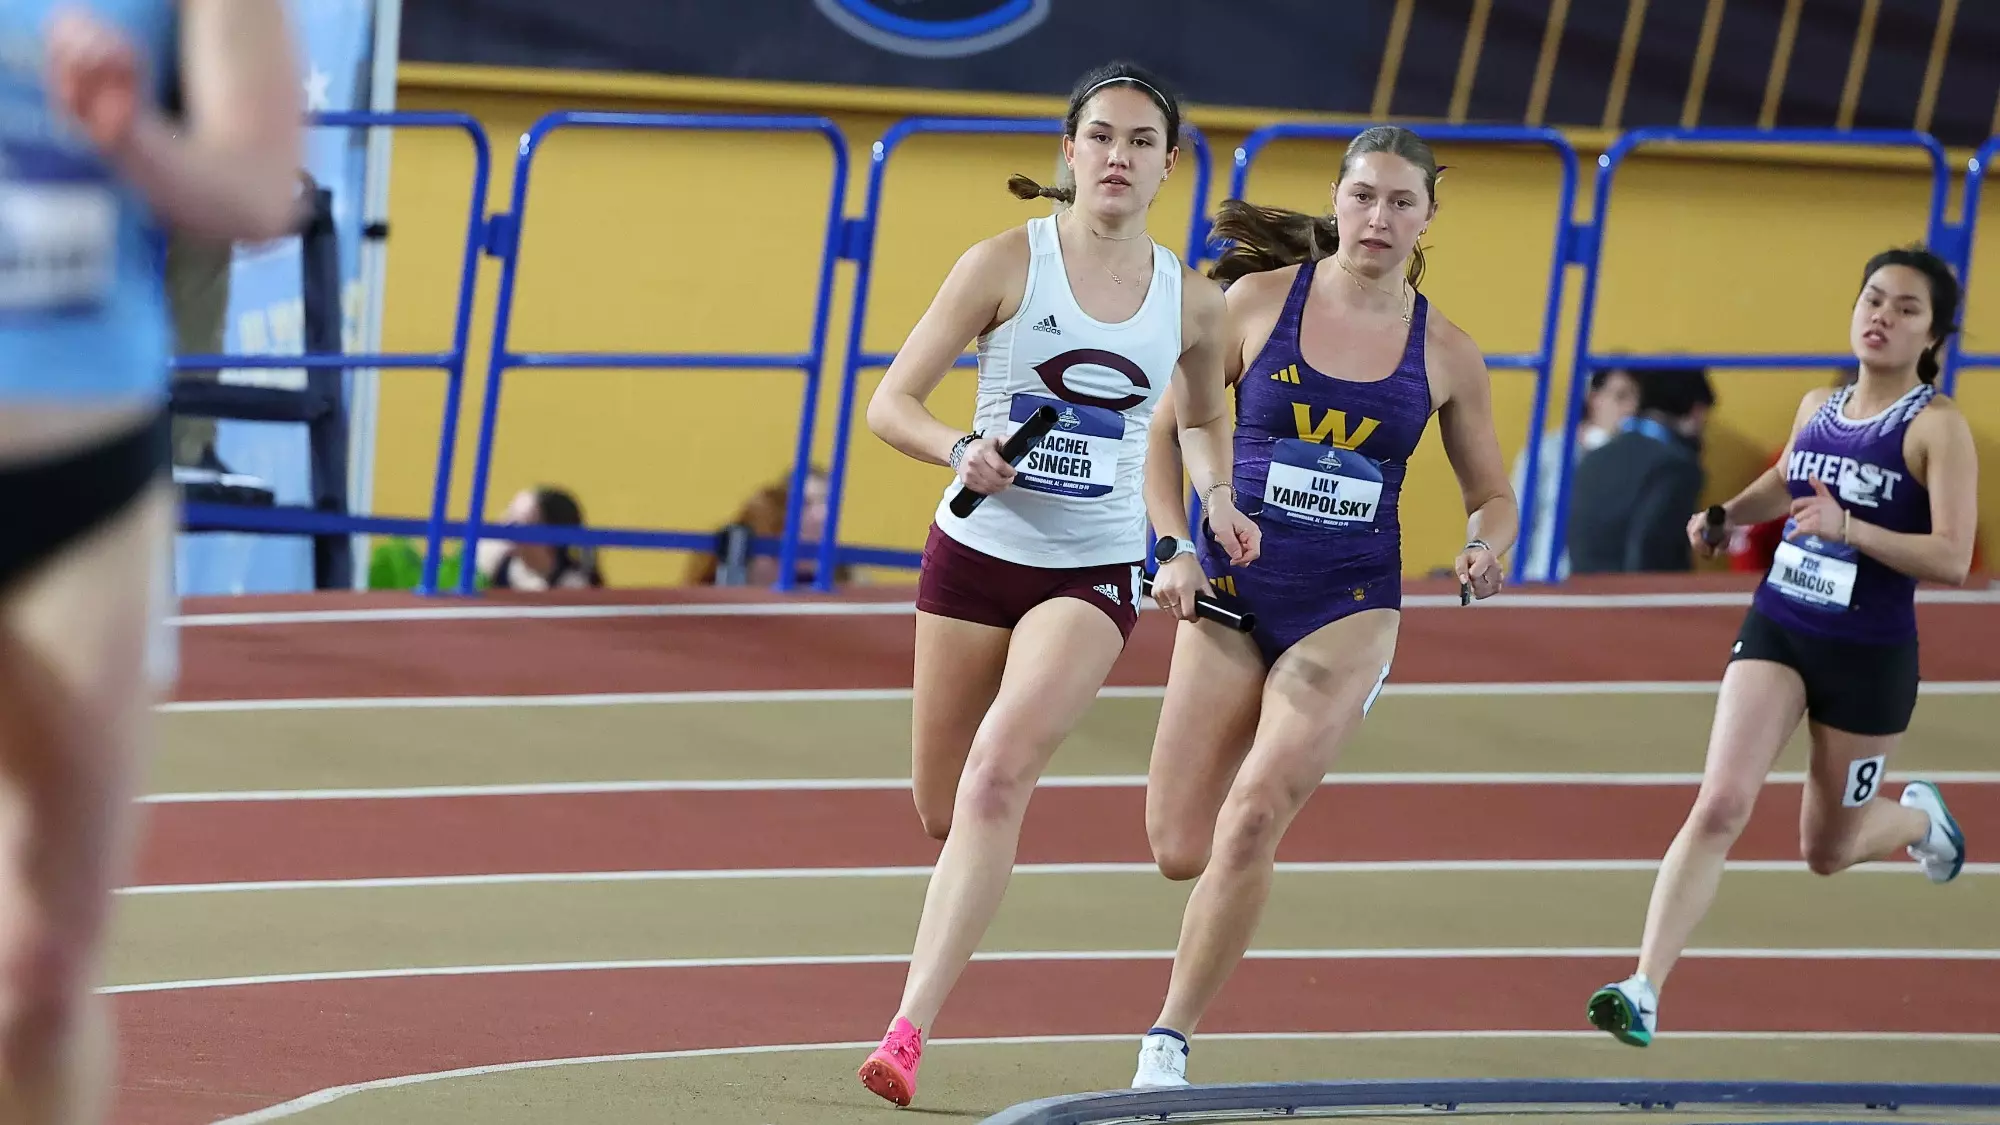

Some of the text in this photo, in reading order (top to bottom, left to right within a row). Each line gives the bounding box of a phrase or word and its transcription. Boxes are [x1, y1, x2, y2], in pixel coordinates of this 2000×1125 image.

[1032, 324, 1061, 335] adidas
[1032, 348, 1151, 411] C
[1291, 402, 1381, 450] W
[1027, 451, 1092, 478] SINGER
[1786, 450, 1902, 501] MHERST
[1311, 476, 1339, 494] LILY
[1272, 485, 1372, 518] YAMPOLSKY
[1093, 585, 1121, 606] adidas
[1782, 566, 1836, 595] MARCUS
[1853, 761, 1877, 803] 8
